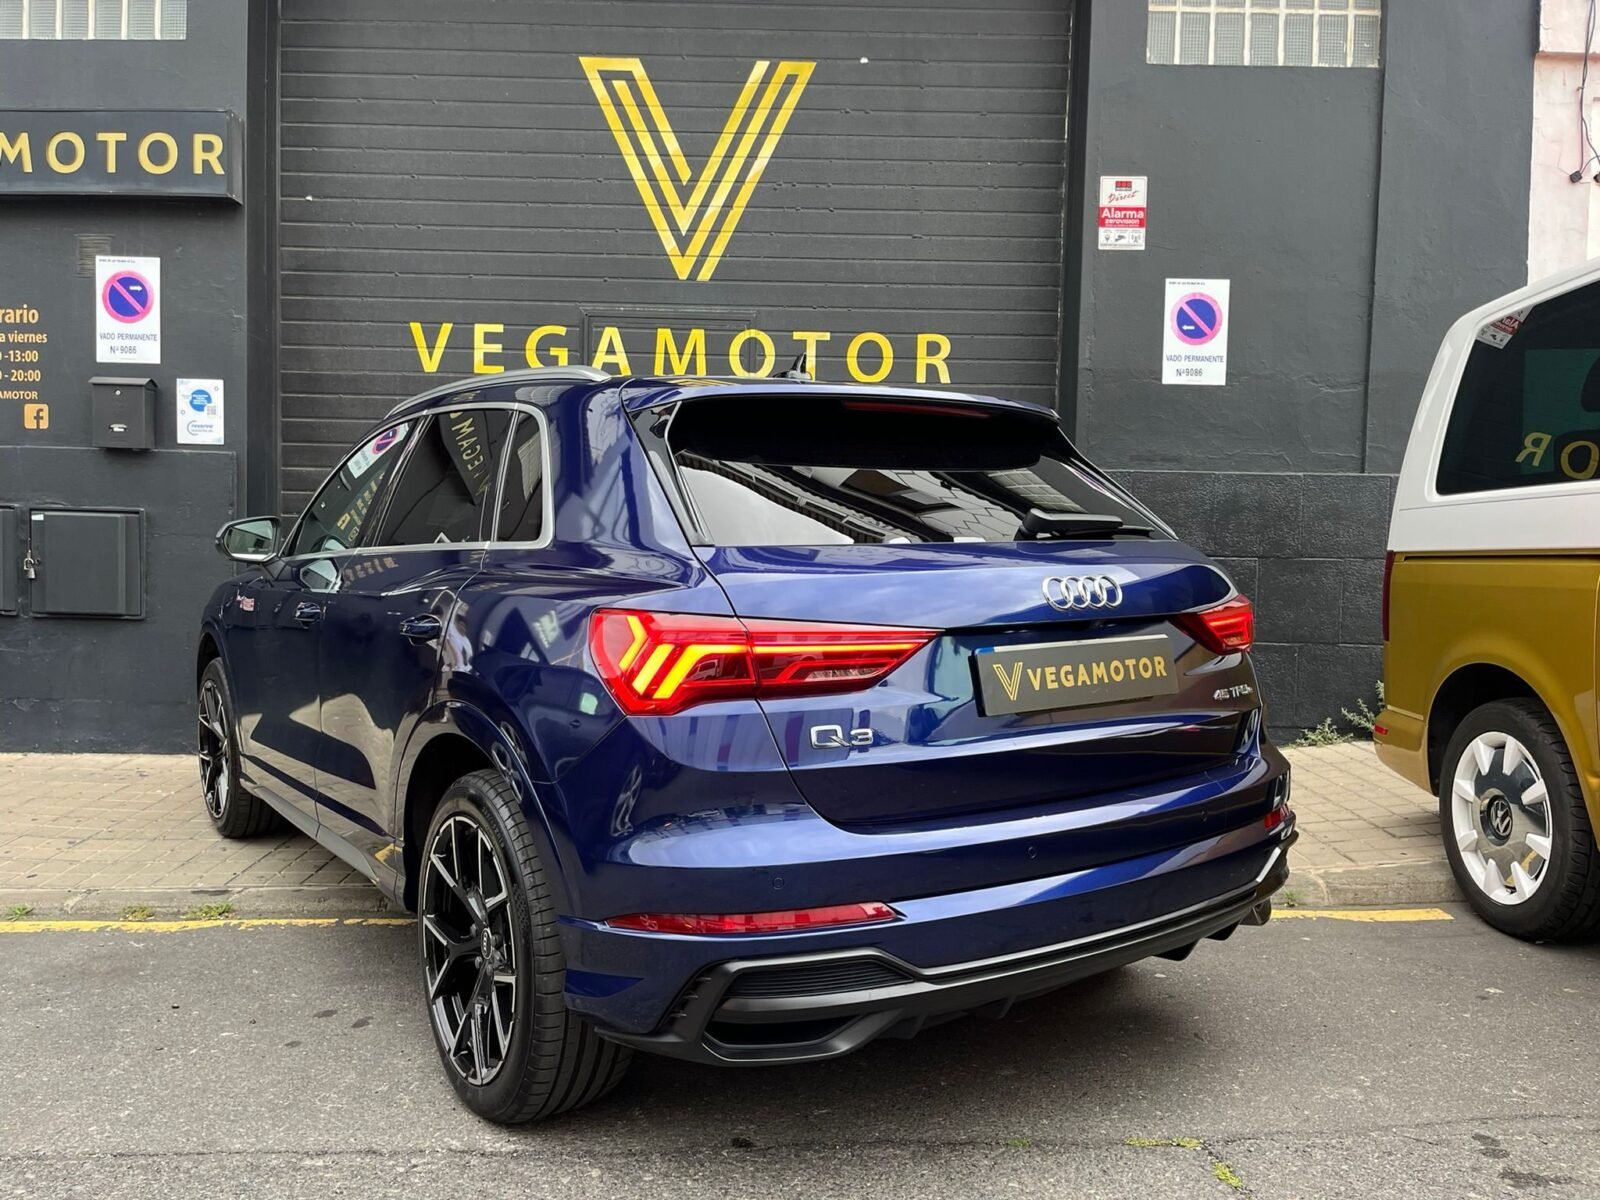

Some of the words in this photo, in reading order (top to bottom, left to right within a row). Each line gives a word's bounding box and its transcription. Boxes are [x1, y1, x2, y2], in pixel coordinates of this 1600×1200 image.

[0, 131, 225, 175] MOTOR
[1101, 207, 1145, 219] Alarma
[8, 330, 48, 343] viernes
[99, 332, 115, 340] VADO
[117, 333, 158, 342] PERMANENTE
[409, 322, 952, 385] VEGAMOTOR
[1166, 354, 1182, 362] VADO
[1184, 354, 1224, 363] PERMANENTE
[10, 369, 41, 382] 20:00
[1185, 368, 1203, 377] 9086
[1026, 655, 1168, 692] VEGAMOTOR
[1213, 688, 1230, 700] 45
[810, 724, 873, 749] Q3
